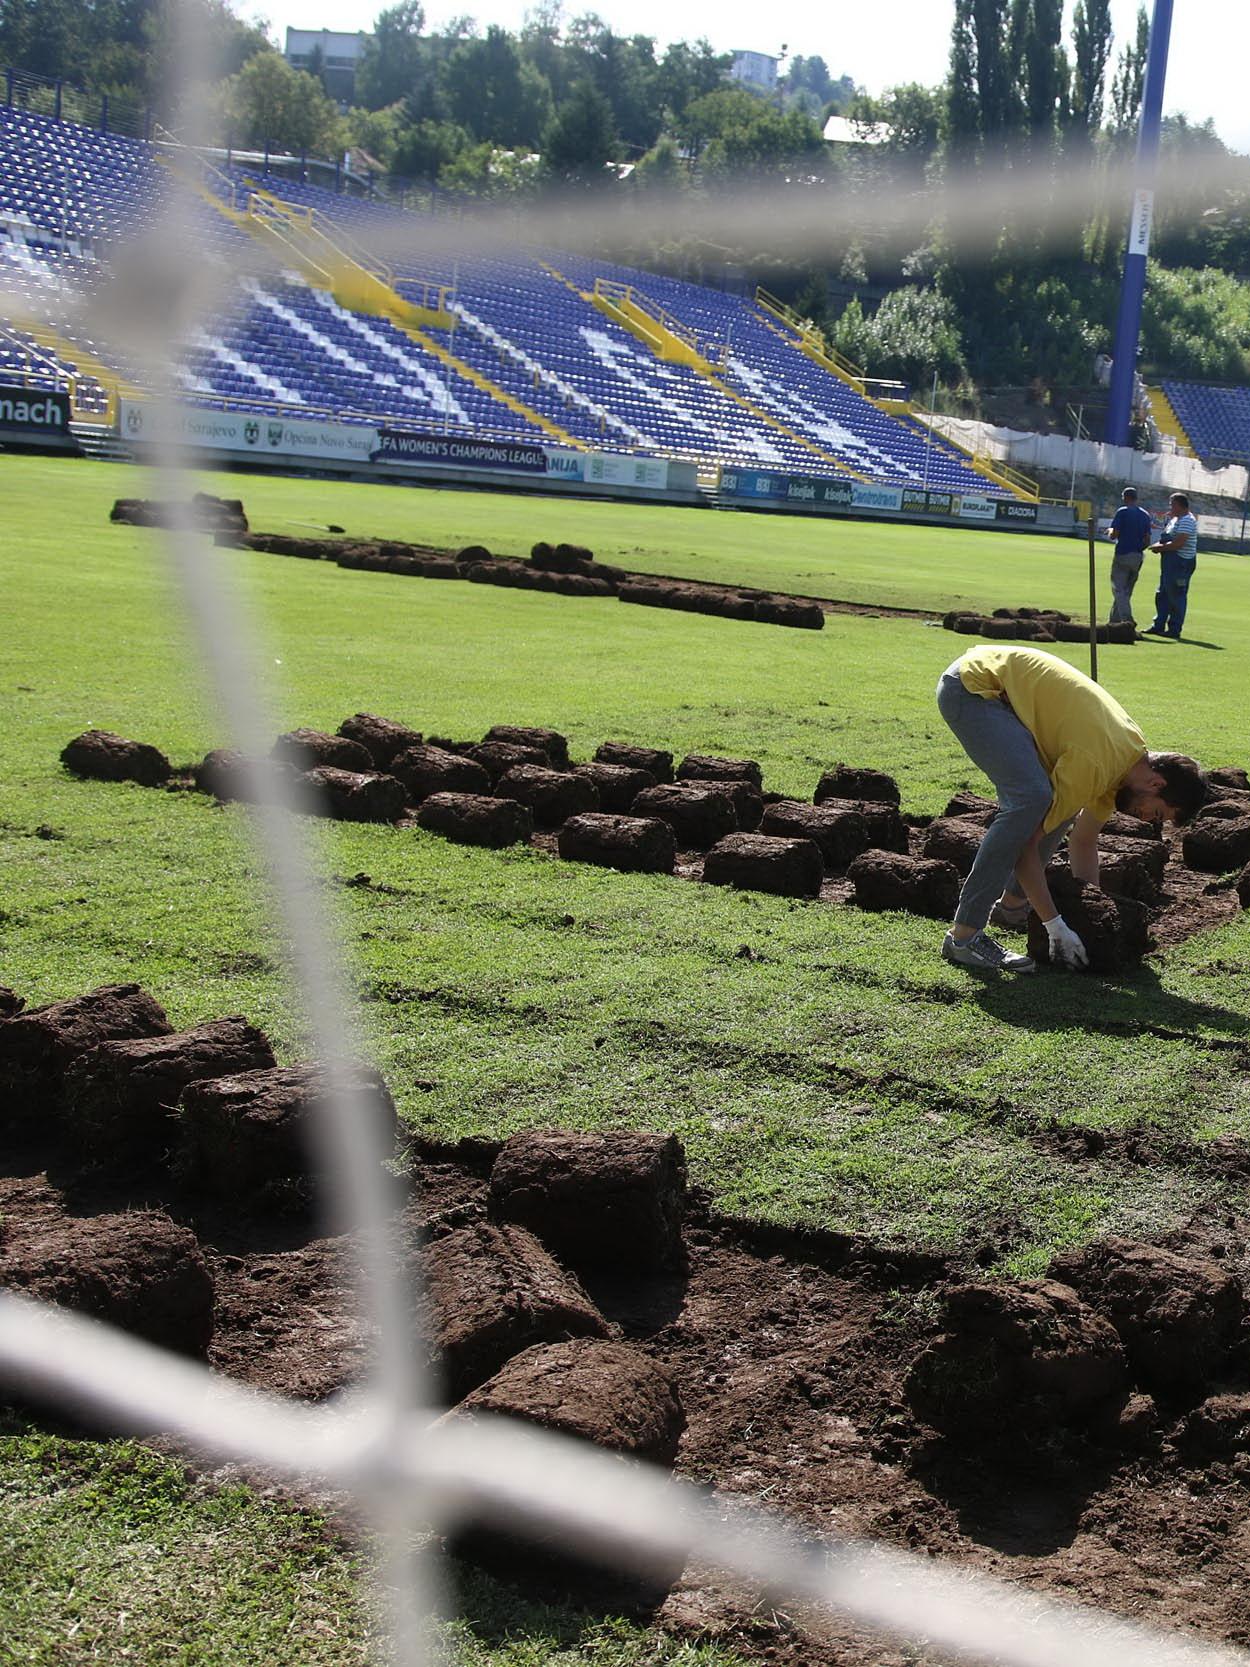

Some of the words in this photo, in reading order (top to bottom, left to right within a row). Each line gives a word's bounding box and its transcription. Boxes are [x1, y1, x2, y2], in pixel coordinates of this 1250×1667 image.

[400, 439, 448, 456] WOMEN'S
[450, 443, 507, 463] CHAMPIONS
[509, 451, 544, 465] LEAGUE
[1008, 506, 1036, 519] DIADORA
